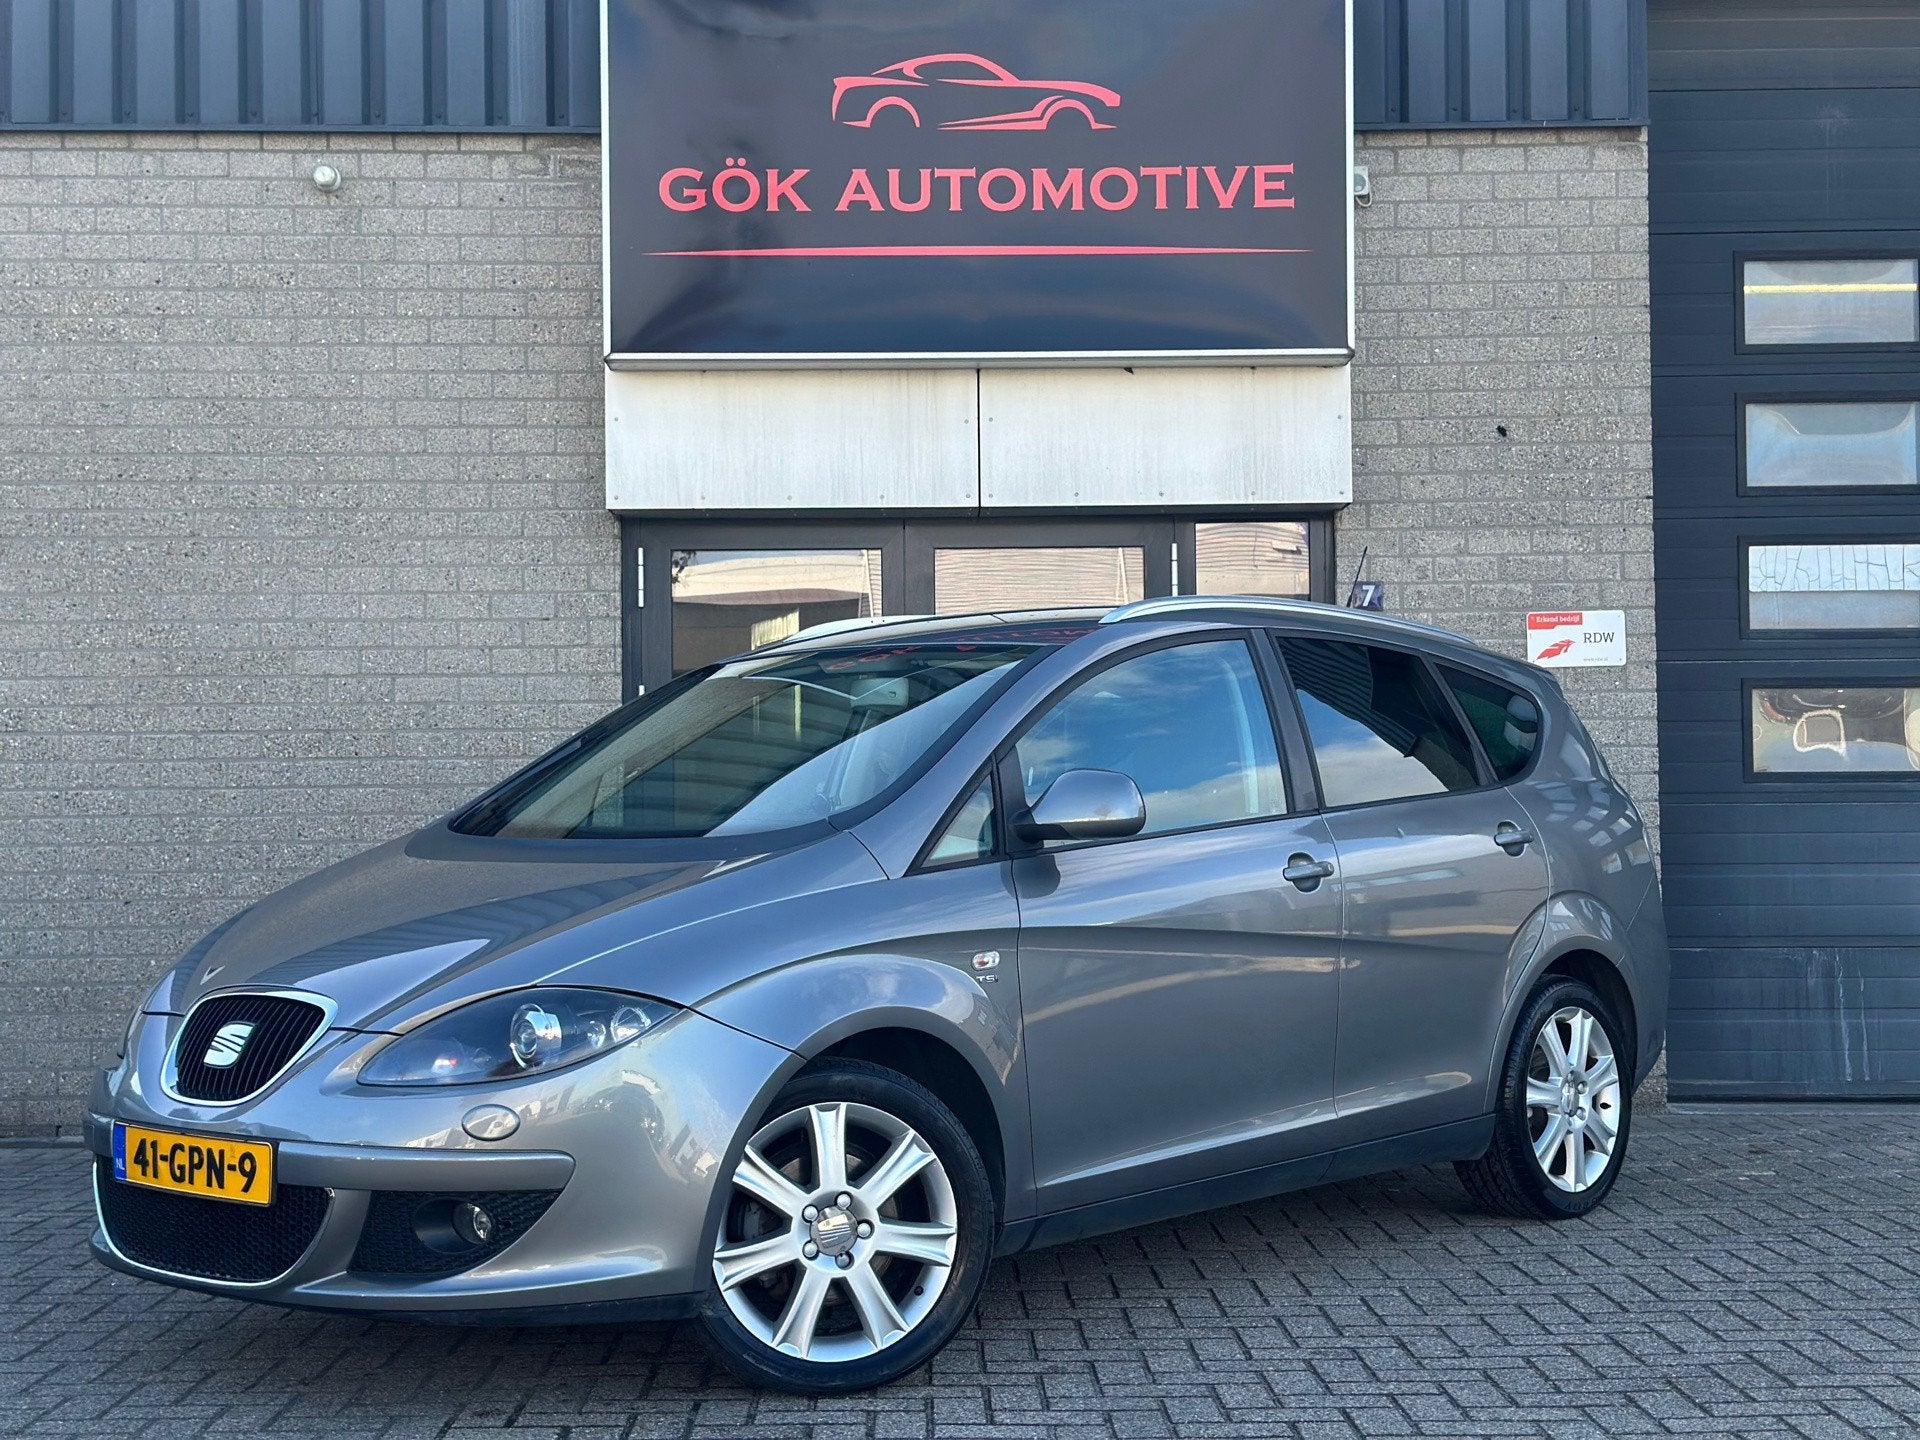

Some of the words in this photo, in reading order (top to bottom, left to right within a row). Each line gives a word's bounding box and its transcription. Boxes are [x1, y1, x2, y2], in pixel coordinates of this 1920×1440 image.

[658, 157, 811, 213] GÖK
[835, 162, 1295, 213] AUTOMOTIVE
[1361, 585, 1376, 607] 7
[1560, 615, 1580, 623] bedrijf
[1583, 632, 1615, 644] RDW
[115, 1157, 125, 1171] NL
[133, 1138, 257, 1194] 41-GPN-9
